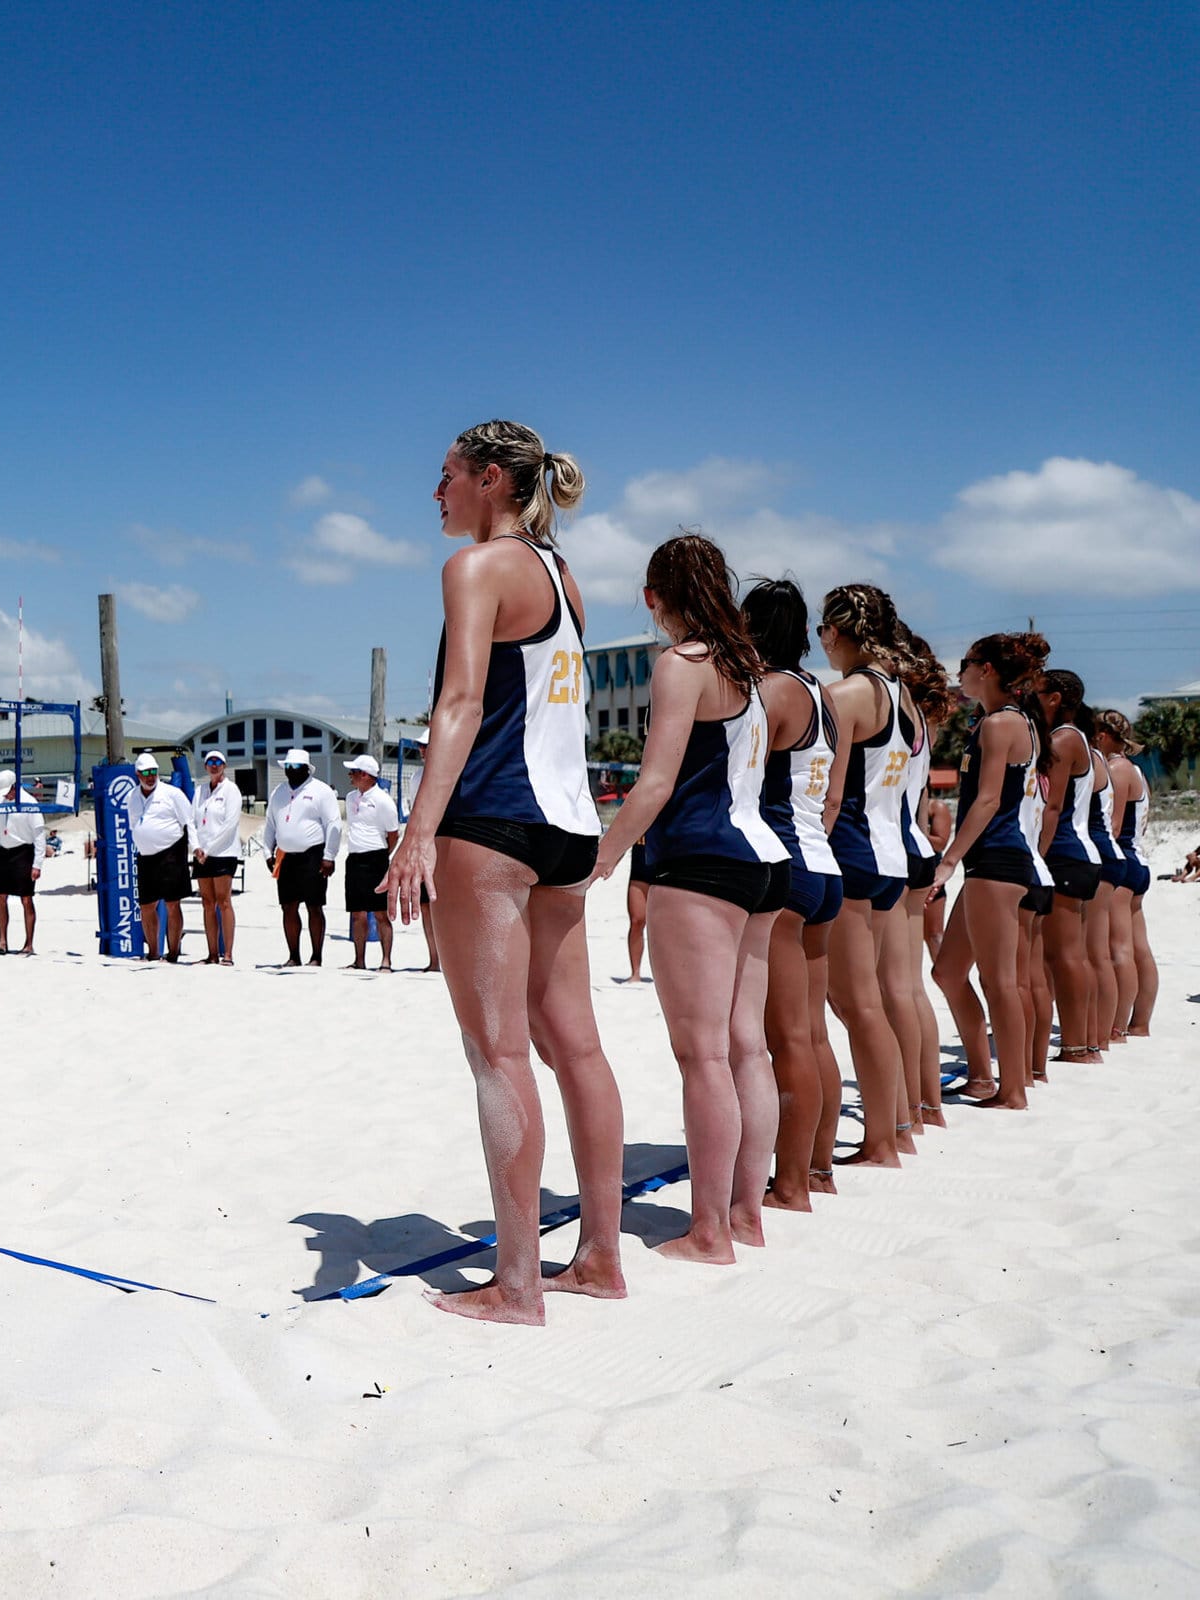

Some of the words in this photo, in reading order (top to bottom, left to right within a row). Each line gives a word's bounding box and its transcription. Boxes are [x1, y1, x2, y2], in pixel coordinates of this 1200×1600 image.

[63, 785, 70, 798] 2
[115, 814, 129, 889] COURT
[117, 896, 133, 953] SAND
